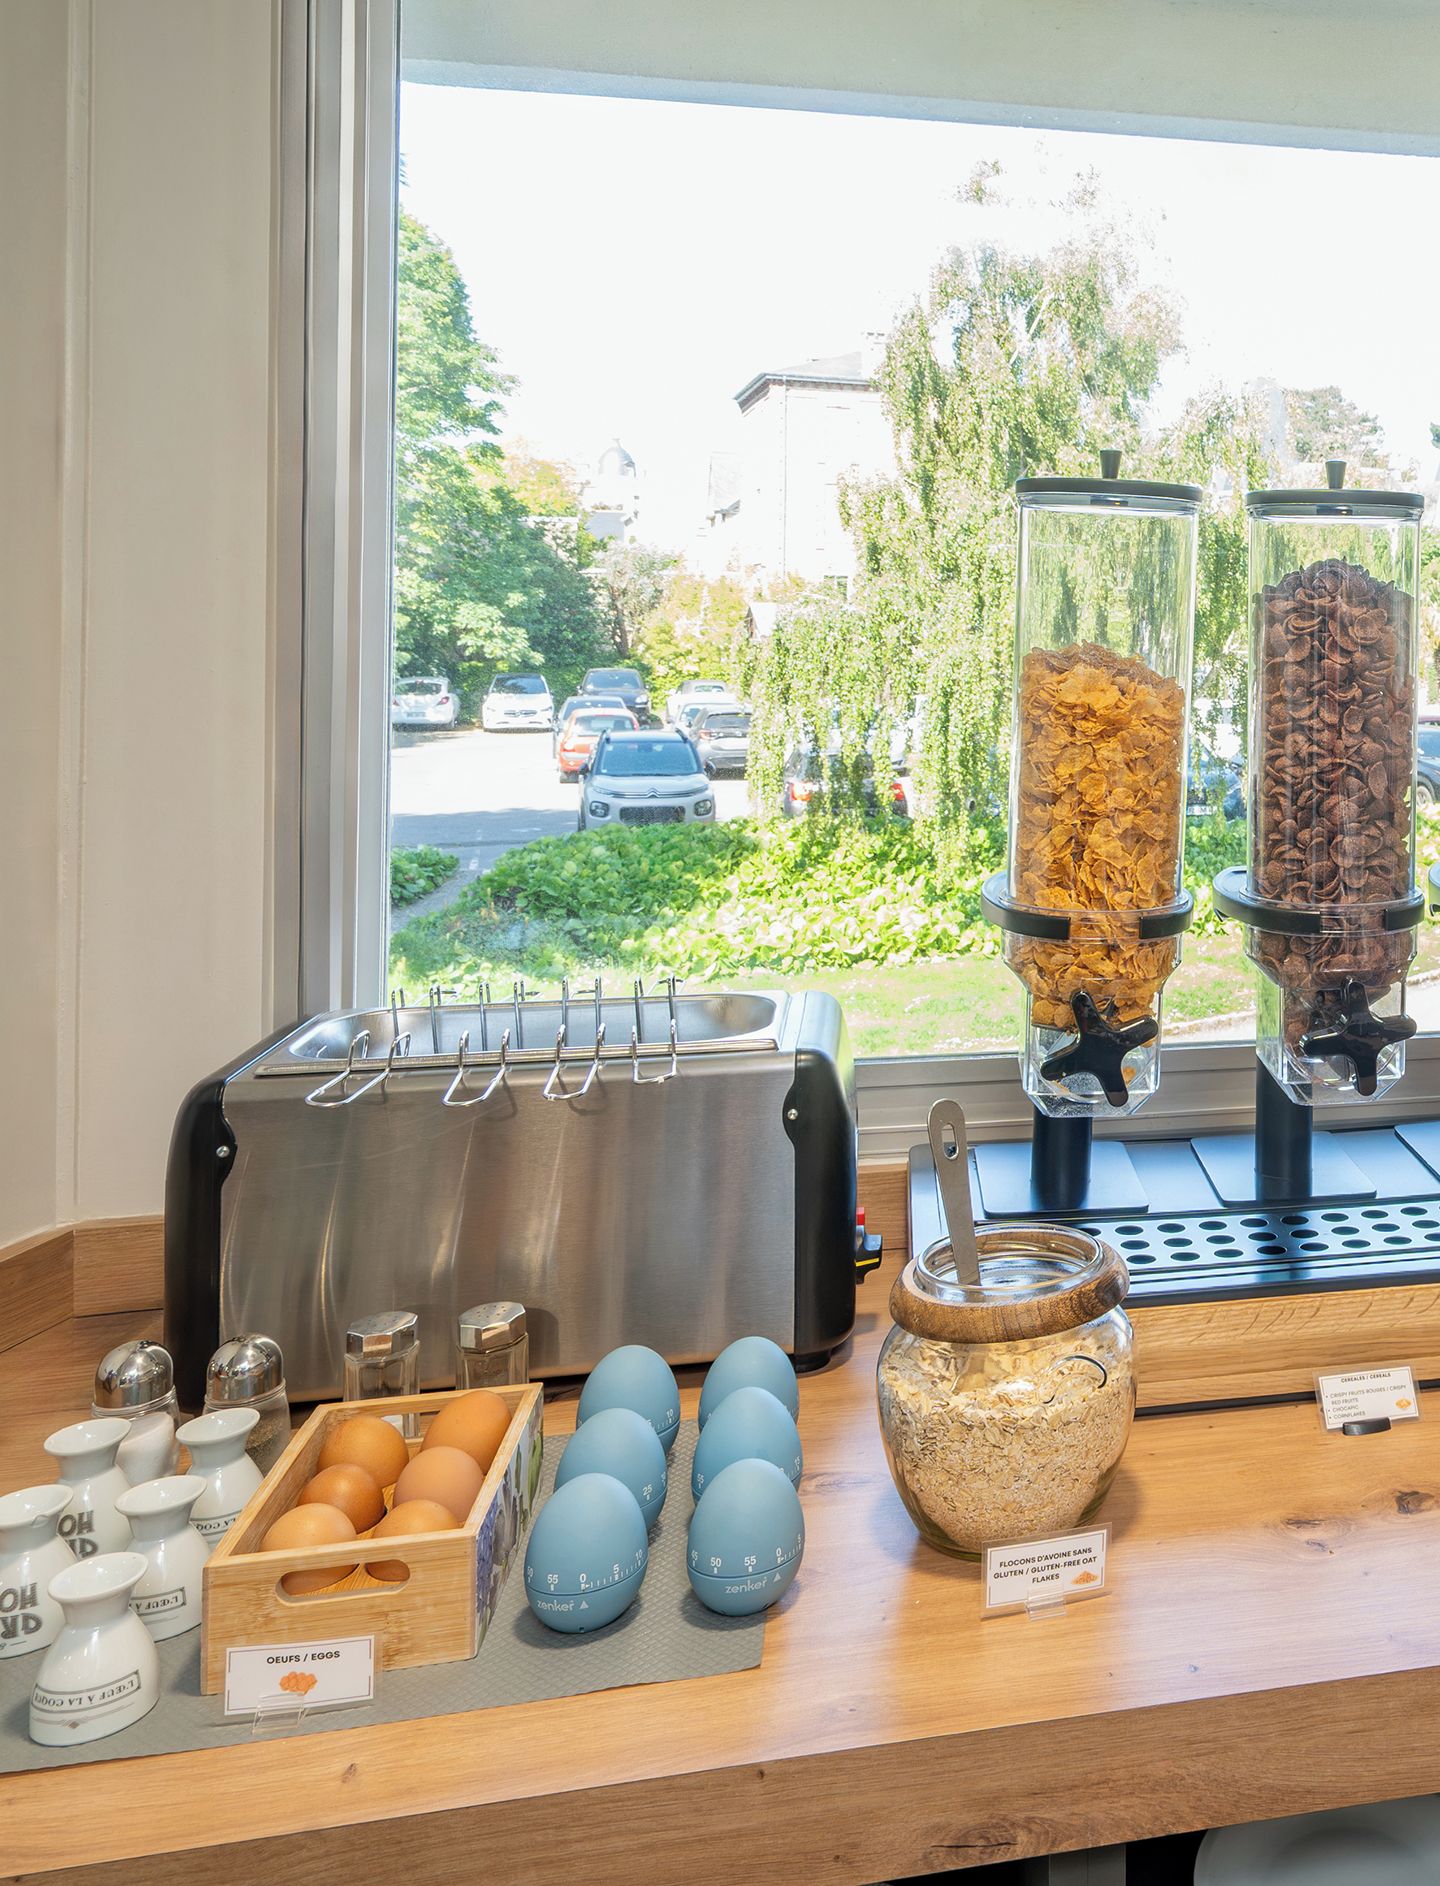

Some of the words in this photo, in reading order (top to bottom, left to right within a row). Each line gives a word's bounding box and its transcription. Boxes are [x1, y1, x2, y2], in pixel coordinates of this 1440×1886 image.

[642, 1483, 653, 1496] 25
[710, 1556, 722, 1568] 50
[744, 1555, 757, 1566] 55
[999, 1556, 1036, 1568] FLOCONS
[1037, 1551, 1071, 1563] D'AVOINE
[1073, 1547, 1093, 1556] SANS
[993, 1568, 1024, 1579] GLUTEN
[1030, 1559, 1081, 1574] GLUTEN-FREE
[1082, 1556, 1098, 1565] OAT
[547, 1573, 559, 1584] 55
[1031, 1573, 1060, 1584] FLAKES
[725, 1577, 768, 1594] zenker
[266, 1654, 301, 1664] OEUFS
[311, 1650, 340, 1661] EGGS
